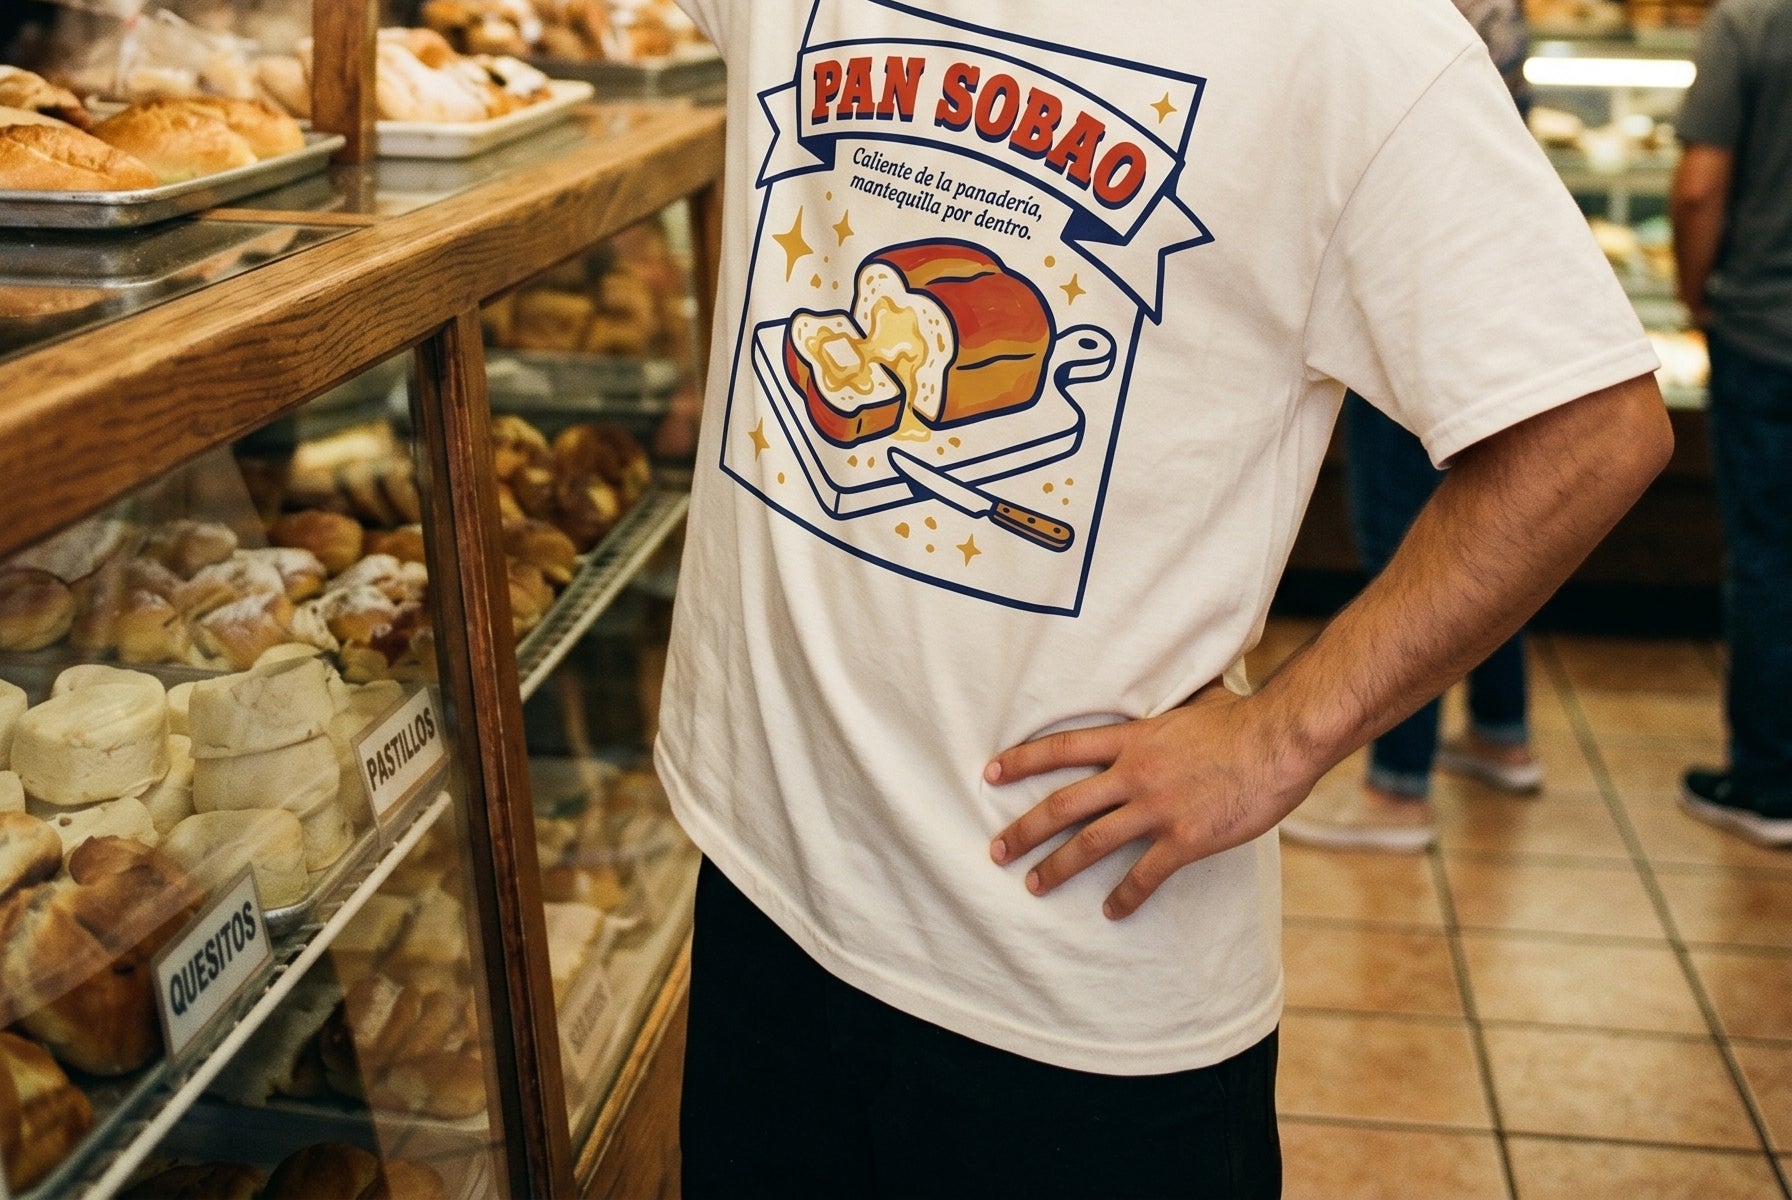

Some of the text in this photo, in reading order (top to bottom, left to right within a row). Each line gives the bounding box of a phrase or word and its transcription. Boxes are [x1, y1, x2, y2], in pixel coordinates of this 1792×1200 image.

[811, 55, 1147, 210] PAN SOBAO
[850, 175, 1032, 240] mantequilla por dentro.
[853, 147, 1043, 222] Caliente de la panadería,
[366, 706, 435, 792] PASTILLOS
[169, 900, 256, 1016] QUESITOS
